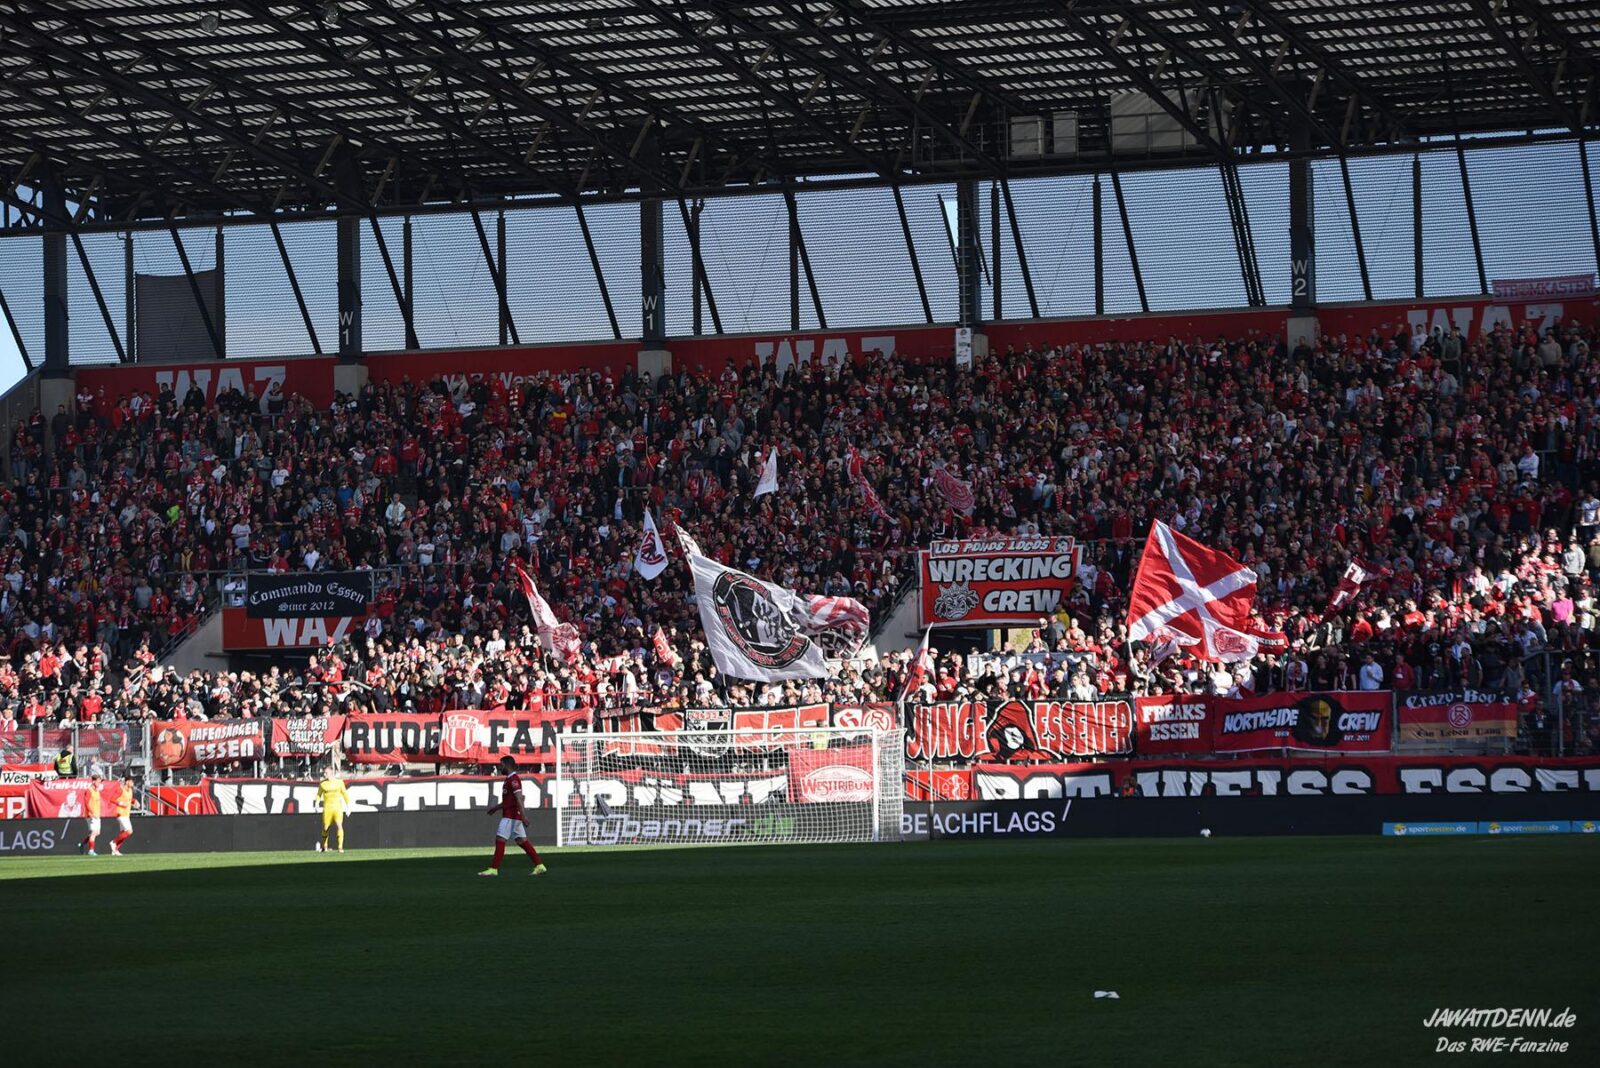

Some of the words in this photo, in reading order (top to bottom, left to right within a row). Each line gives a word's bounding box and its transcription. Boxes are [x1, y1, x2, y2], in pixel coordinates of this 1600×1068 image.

[1291, 260, 1308, 275] W
[1294, 279, 1307, 296] 2
[643, 296, 657, 310] W
[339, 311, 354, 326] W
[647, 314, 654, 330] 1
[1407, 303, 1563, 350] WAZ
[343, 330, 350, 345] 1
[935, 541, 959, 554] LOS
[1009, 539, 1050, 551] LOCOS
[928, 554, 1072, 582] WRECKING
[250, 582, 322, 605] Commando
[326, 582, 366, 605] Essen
[983, 589, 1061, 613] CREW
[309, 600, 335, 612] 2012
[1141, 703, 1206, 723] FREAKS
[1223, 708, 1299, 734] NORTHSIDE
[1338, 712, 1380, 731] CREW
[351, 720, 440, 755] RUDE
[488, 718, 590, 755] FANS
[906, 700, 988, 758] JUNGE
[1034, 700, 1134, 756] ESSENER
[1149, 722, 1200, 742] ESSEN
[194, 739, 254, 761] ESSEN
[901, 810, 1056, 835] BEACHFLAGS
[1408, 824, 1467, 834] sportwetten.de
[1, 830, 56, 850] LAGS
